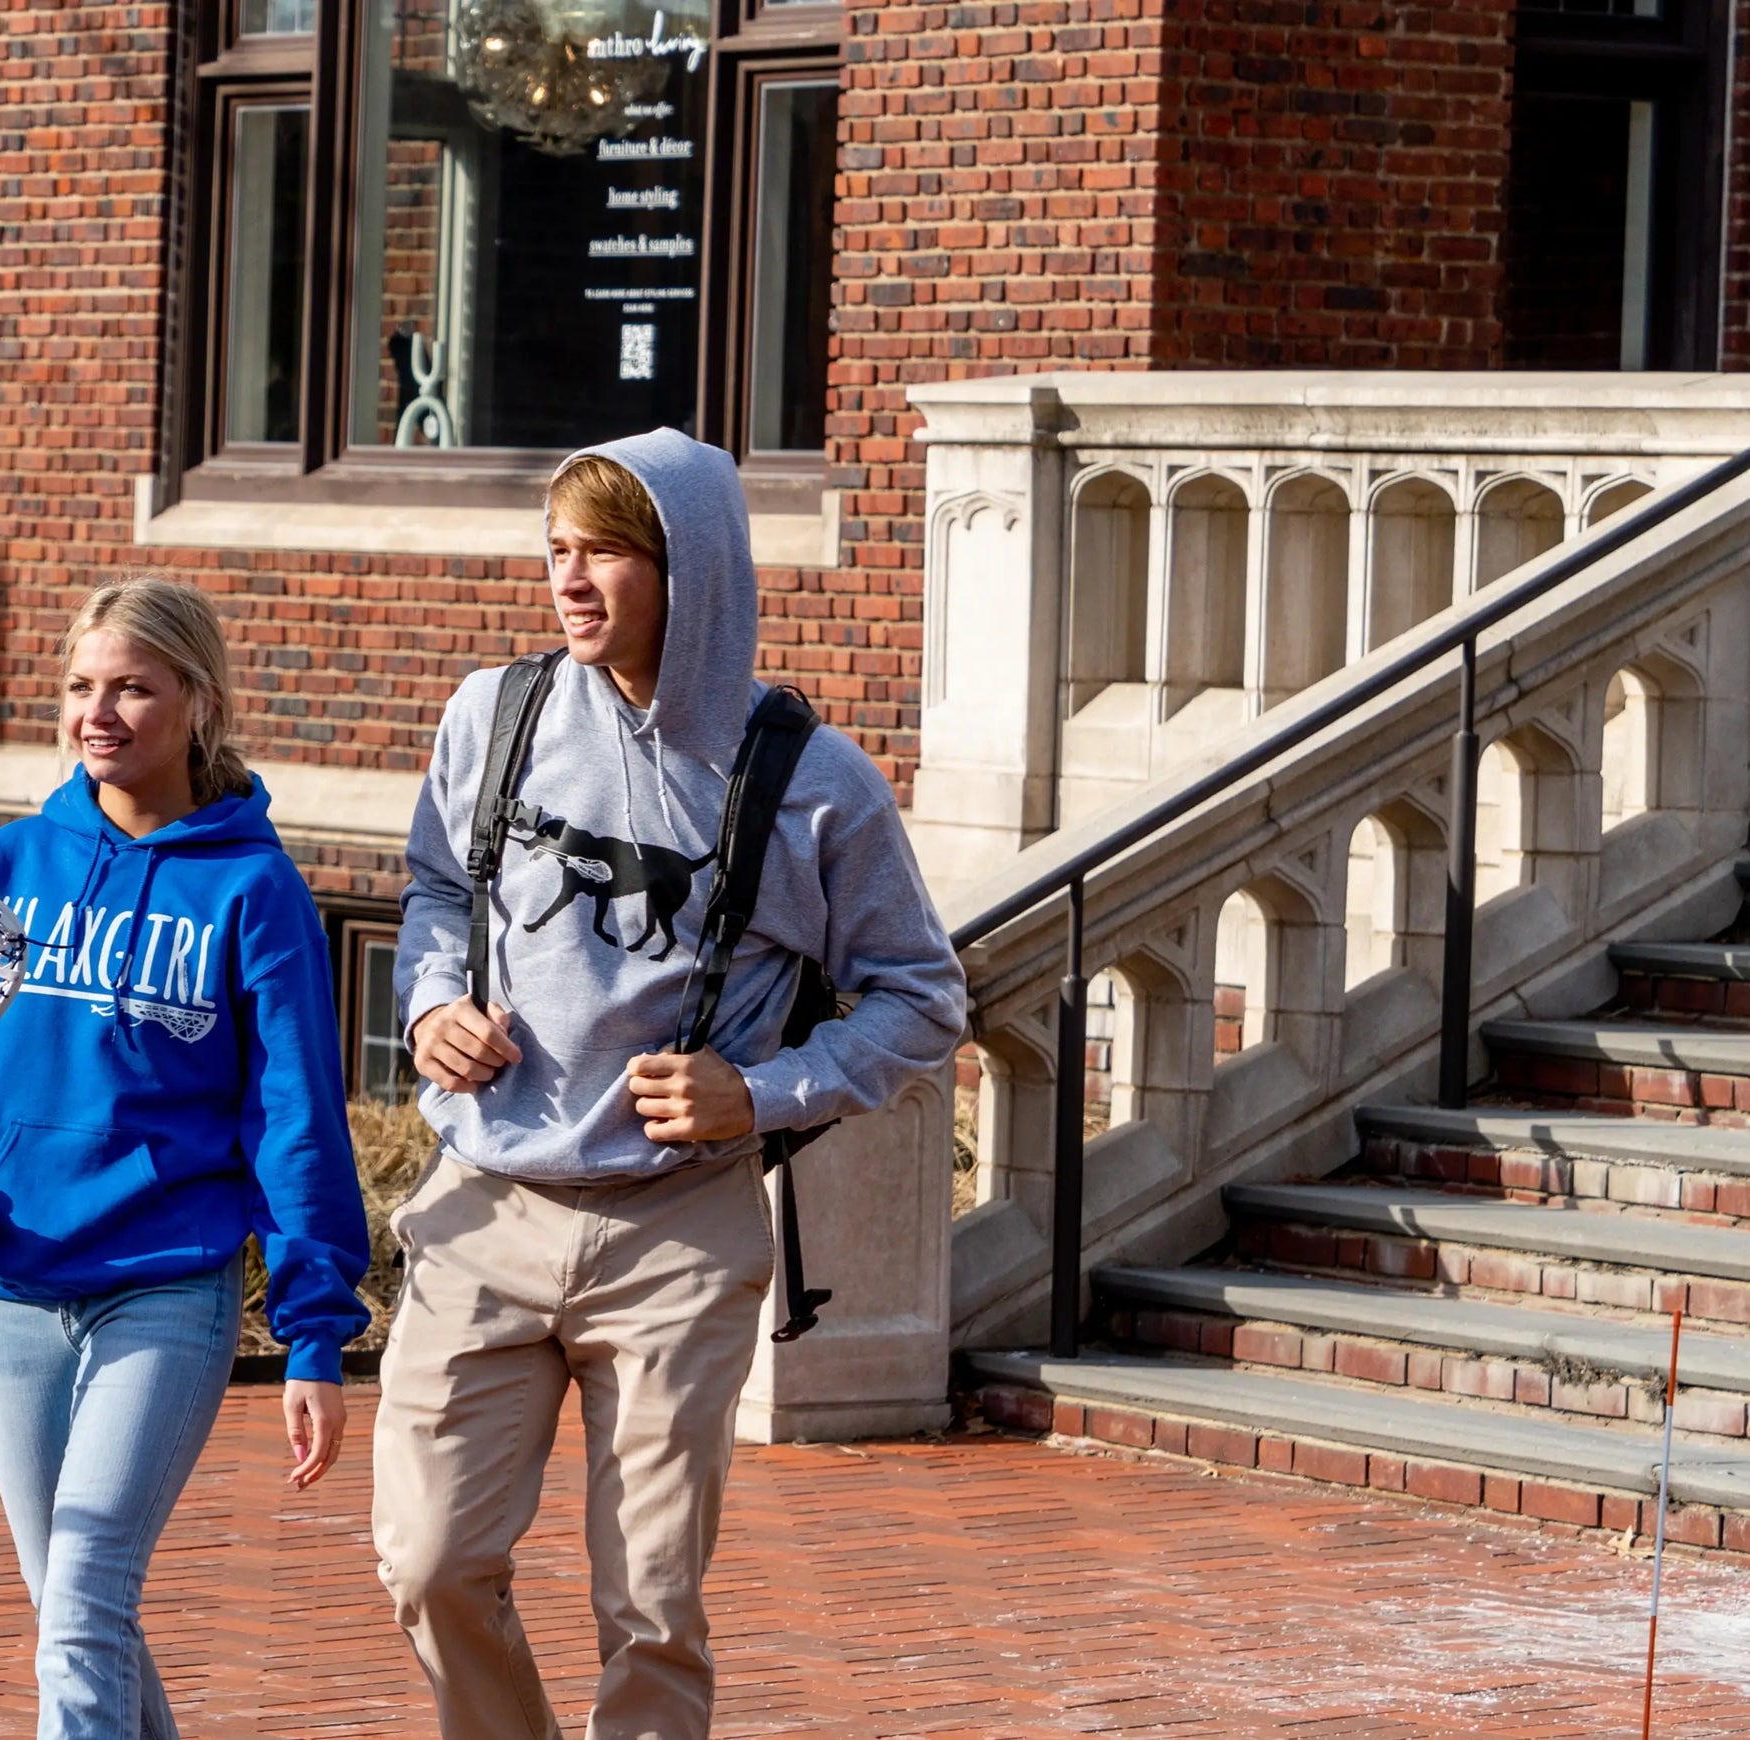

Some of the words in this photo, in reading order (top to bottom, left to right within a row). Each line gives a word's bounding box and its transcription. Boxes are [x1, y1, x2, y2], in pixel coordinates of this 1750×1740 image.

[587, 31, 644, 58] anthro
[645, 9, 707, 73] living
[599, 138, 648, 157] furniture
[649, 136, 658, 155] &
[659, 136, 693, 155] décor
[608, 186, 638, 205] home
[639, 185, 678, 210] styling
[589, 234, 636, 254] swatches
[638, 234, 648, 253] &
[649, 232, 694, 258] samples
[3, 896, 216, 1009] LAXGIRL
